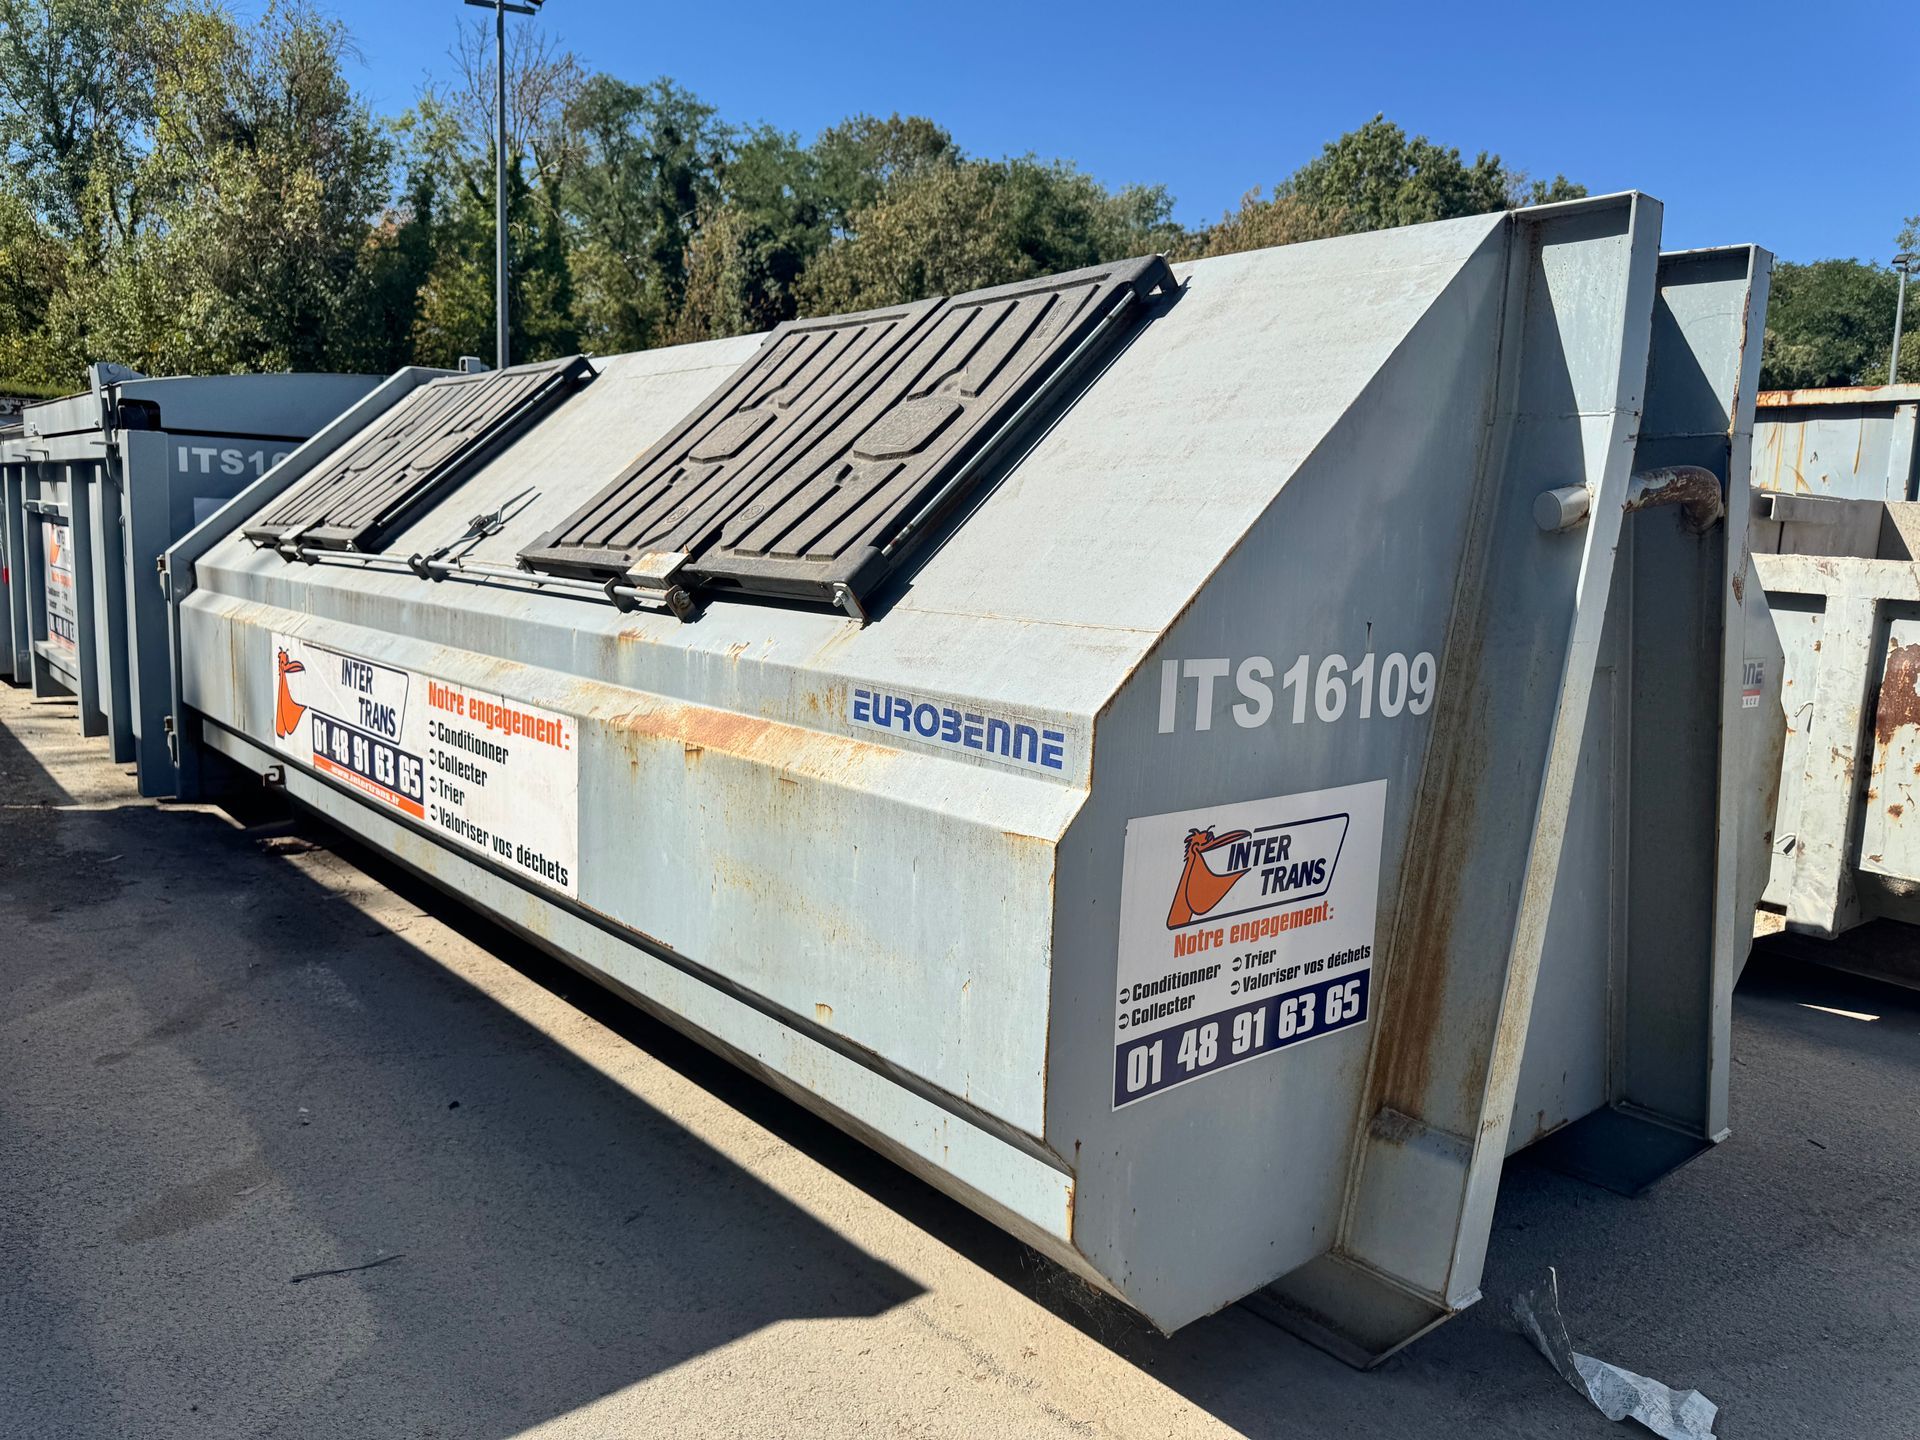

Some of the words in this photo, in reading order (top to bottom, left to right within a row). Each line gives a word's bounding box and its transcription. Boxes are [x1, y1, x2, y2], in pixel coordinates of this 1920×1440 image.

[341, 658, 373, 695] INTER
[1158, 651, 1437, 734] ITS16109
[358, 696, 396, 737] TRANS
[428, 681, 464, 715] Notre
[438, 722, 509, 765] Conditionner
[853, 688, 1065, 770] EUROBENNE
[313, 718, 328, 755] 01
[331, 726, 350, 764] 48
[353, 735, 370, 775] 91
[374, 745, 395, 786] 63
[399, 755, 422, 799] 65
[438, 750, 488, 787] Collecter
[438, 778, 465, 807] Trier
[439, 806, 489, 847] Valoriser
[492, 834, 513, 859] vos
[516, 843, 569, 887] déchets
[1226, 834, 1291, 872] INTER
[1260, 858, 1326, 896] TRANS
[1173, 926, 1223, 958] Notre
[1230, 900, 1334, 945] engagement:
[1242, 965, 1301, 992] Valoriser
[1303, 959, 1324, 975] vos
[1327, 945, 1371, 968] déchets
[1244, 950, 1277, 970] Trier
[1132, 963, 1221, 1002] Conditionner
[1131, 994, 1195, 1027] Collecter
[1126, 1039, 1163, 1093] 01
[1176, 1021, 1219, 1072] 48
[1231, 1006, 1267, 1055] 91
[1277, 992, 1316, 1039] 63
[1324, 979, 1361, 1025] 65
